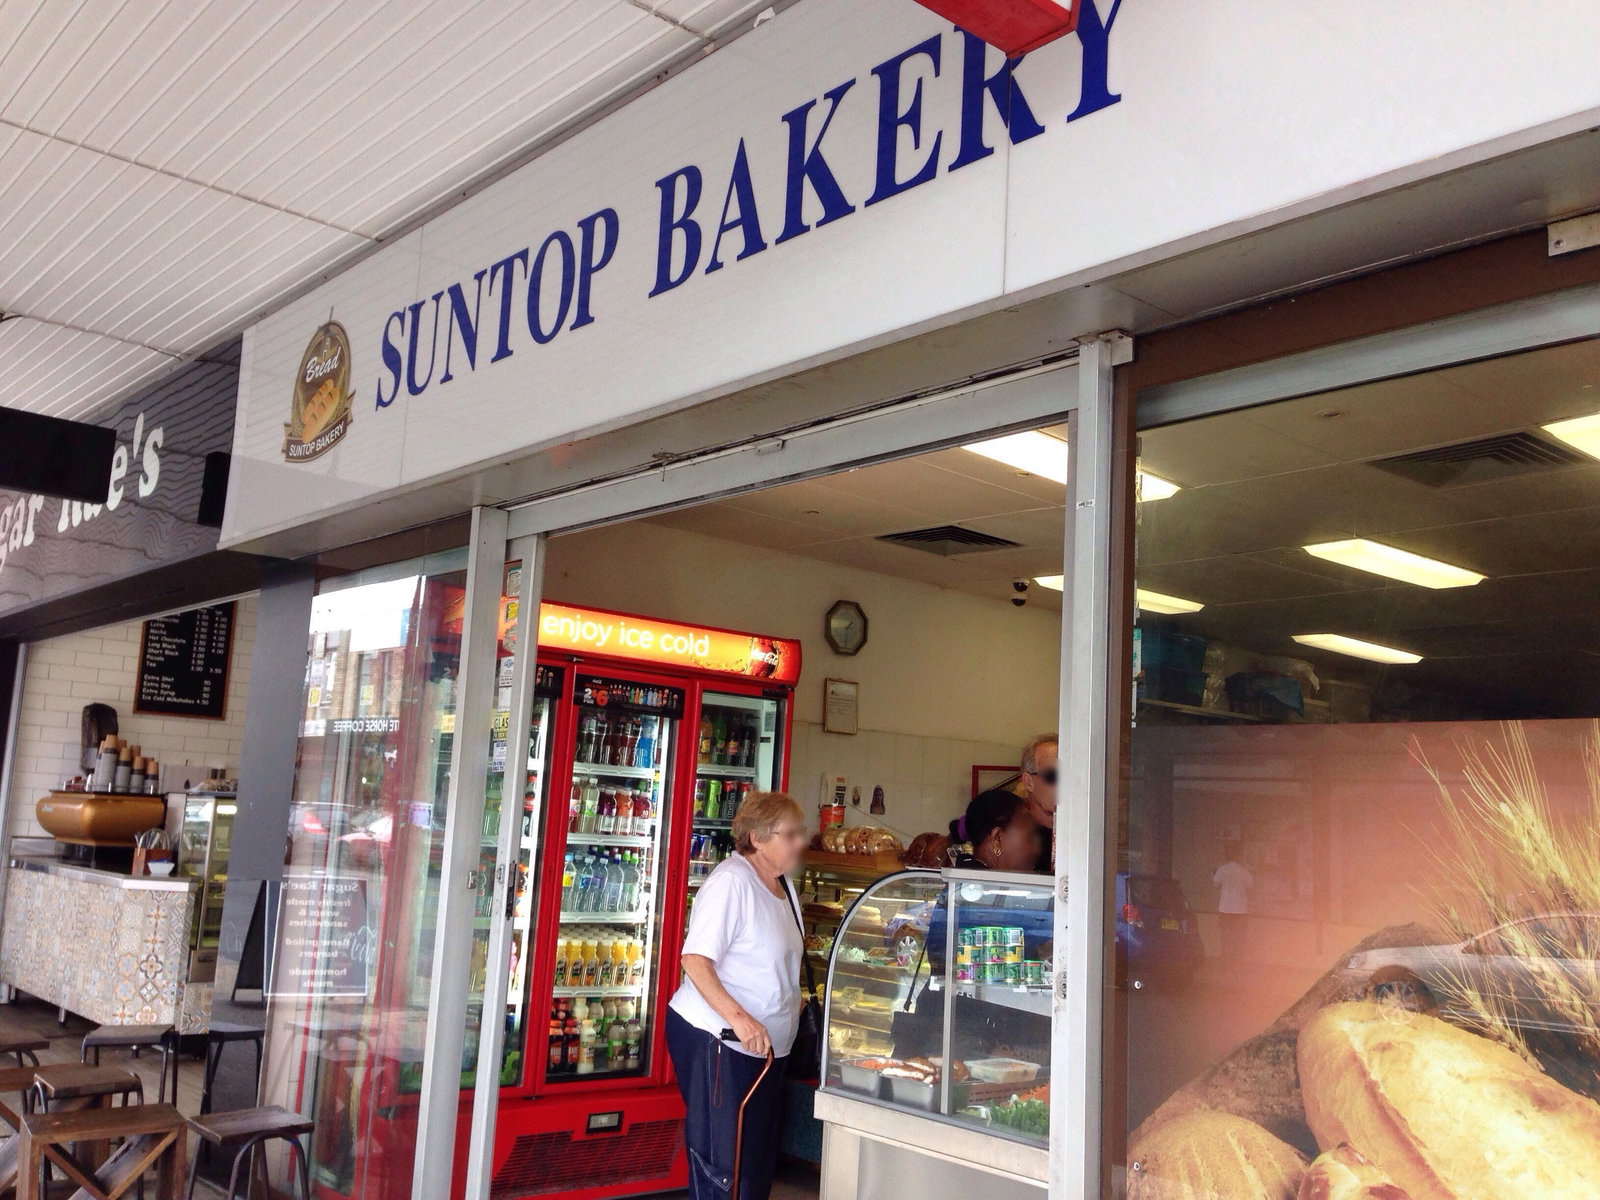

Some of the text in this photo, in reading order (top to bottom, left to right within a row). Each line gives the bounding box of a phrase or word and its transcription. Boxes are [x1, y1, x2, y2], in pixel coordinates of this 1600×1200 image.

[375, 207, 618, 411] SUNTOP
[305, 347, 341, 383] Bread
[289, 421, 345, 457] SUNTOP BAKERY
[543, 614, 710, 657] enjoy ice cold
[584, 687, 592, 699] 2
